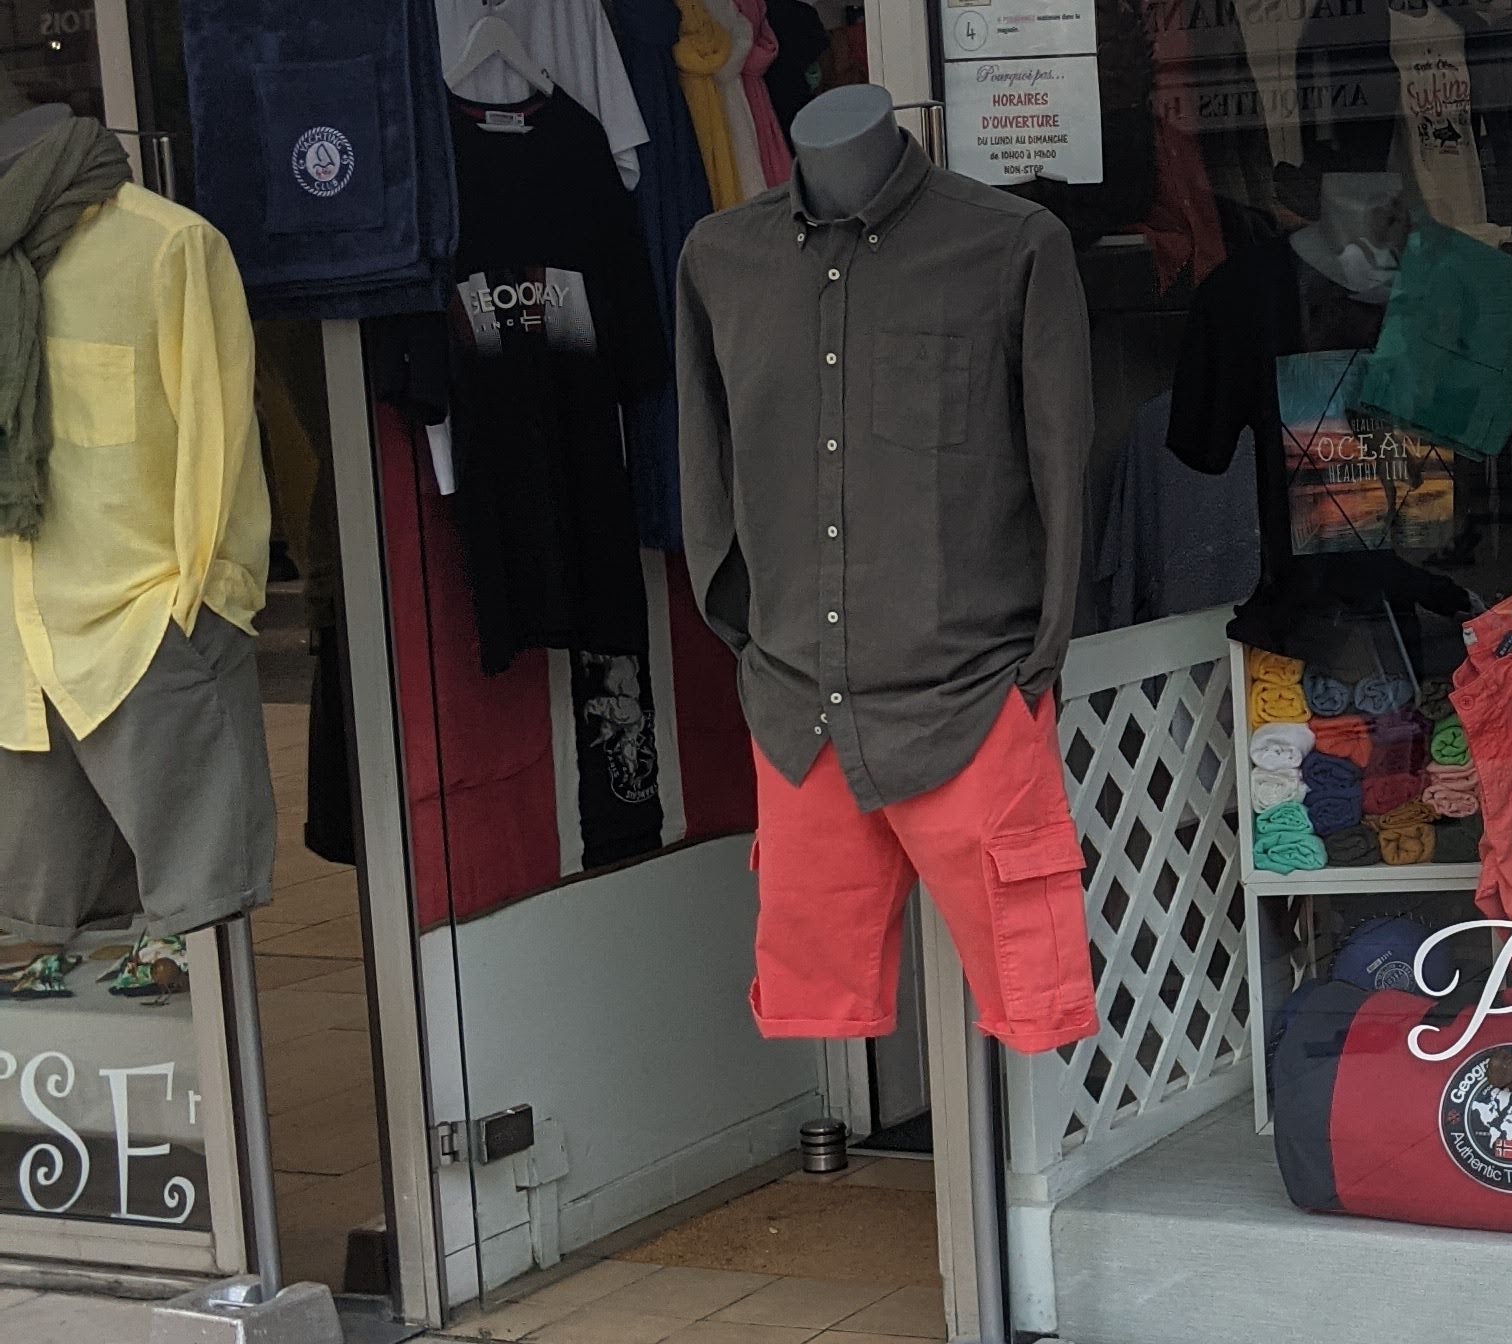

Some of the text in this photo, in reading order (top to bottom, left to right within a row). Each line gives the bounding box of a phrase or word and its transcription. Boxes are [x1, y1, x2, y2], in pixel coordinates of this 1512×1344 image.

[992, 92, 1049, 107] HORAIRES
[981, 113, 1060, 129] D'OUVERTURE
[977, 136, 988, 146] DU
[990, 135, 1013, 146] LUNDI
[1015, 135, 1026, 145] AU
[1003, 164, 1044, 175] NON-STOP
[1316, 432, 1421, 462] OCEAN
[1328, 461, 1378, 484] HEALTHY
[1451, 1131, 1502, 1182] Authentic
